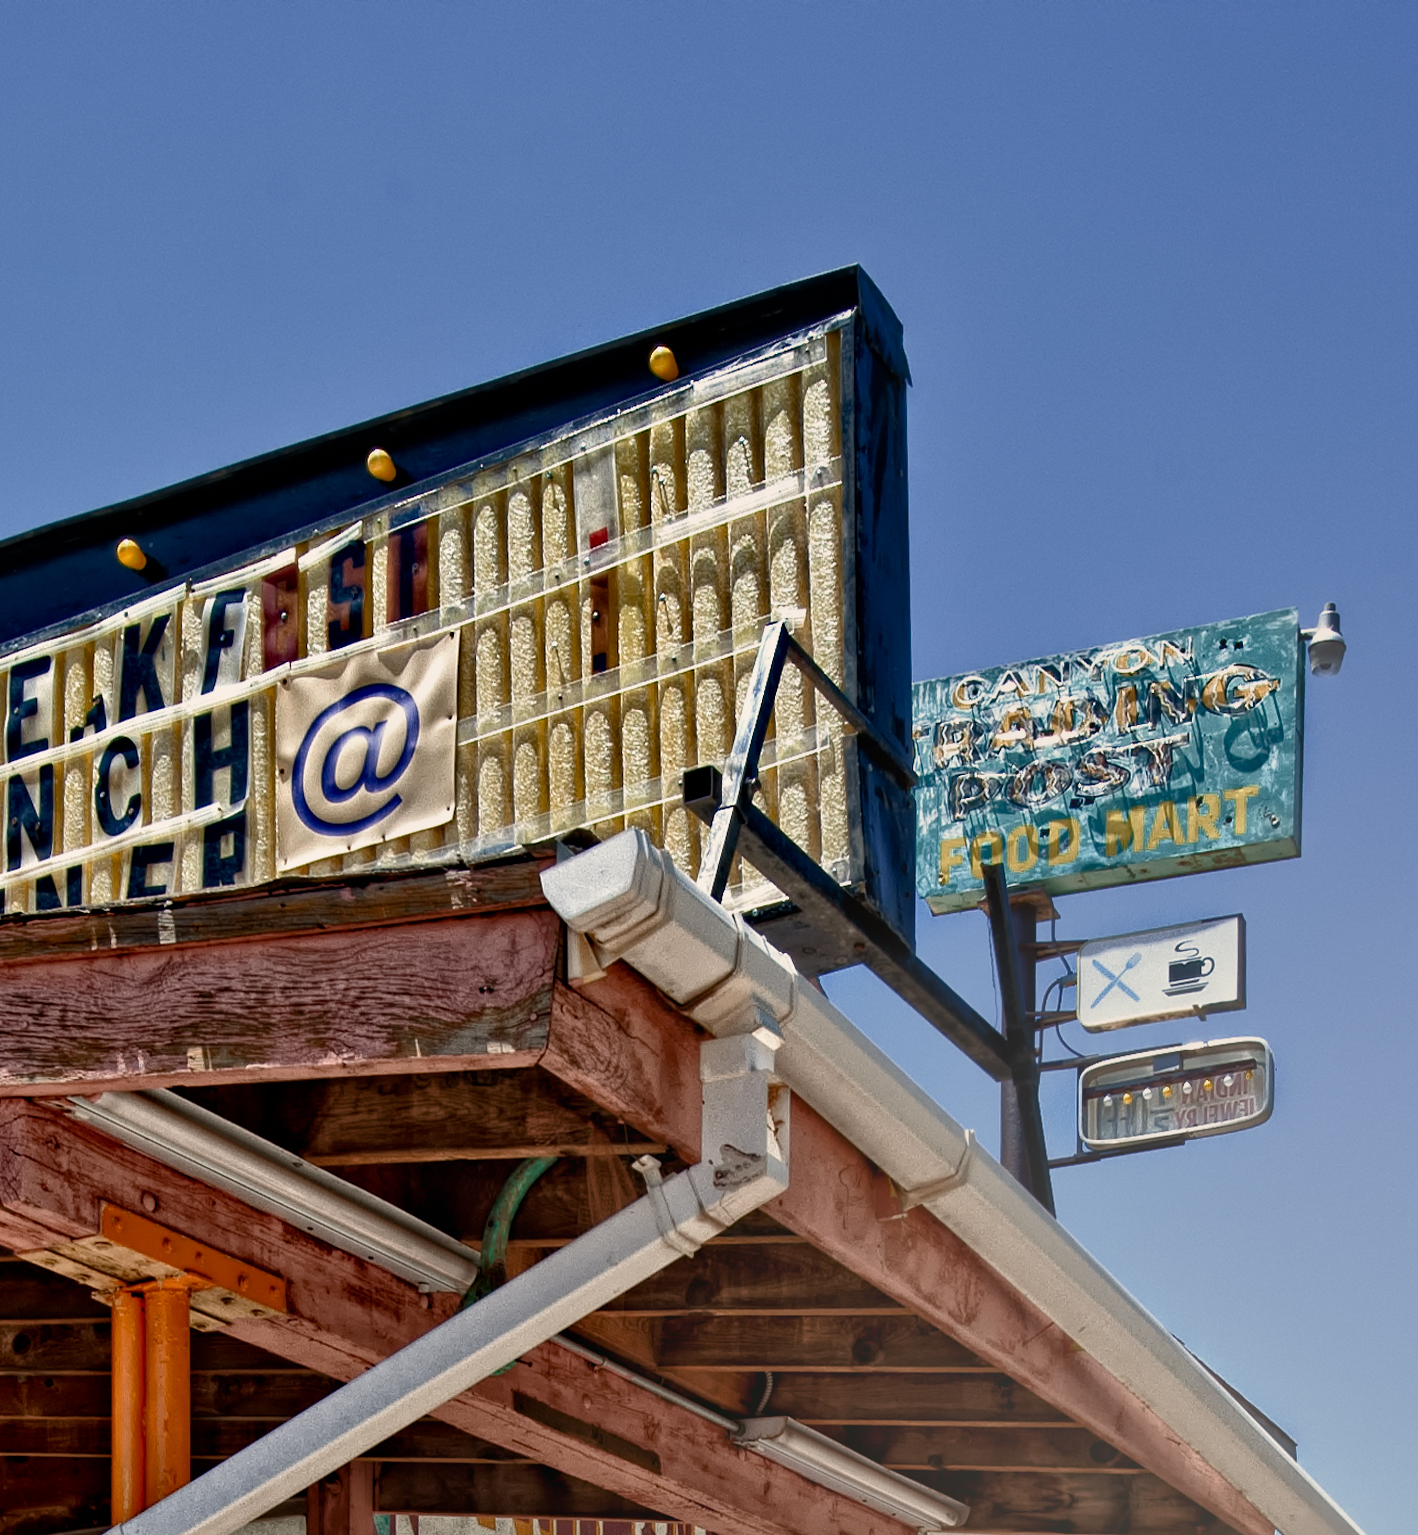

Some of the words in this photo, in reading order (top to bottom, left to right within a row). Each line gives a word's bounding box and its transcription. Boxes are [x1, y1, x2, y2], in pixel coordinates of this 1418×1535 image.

[913, 661, 1281, 772] RADING
[951, 637, 1196, 711] CANYON
[293, 683, 420, 836] @
[950, 732, 1190, 822] POST
[938, 816, 1083, 886] FOOD
[1105, 785, 1260, 858] MART
